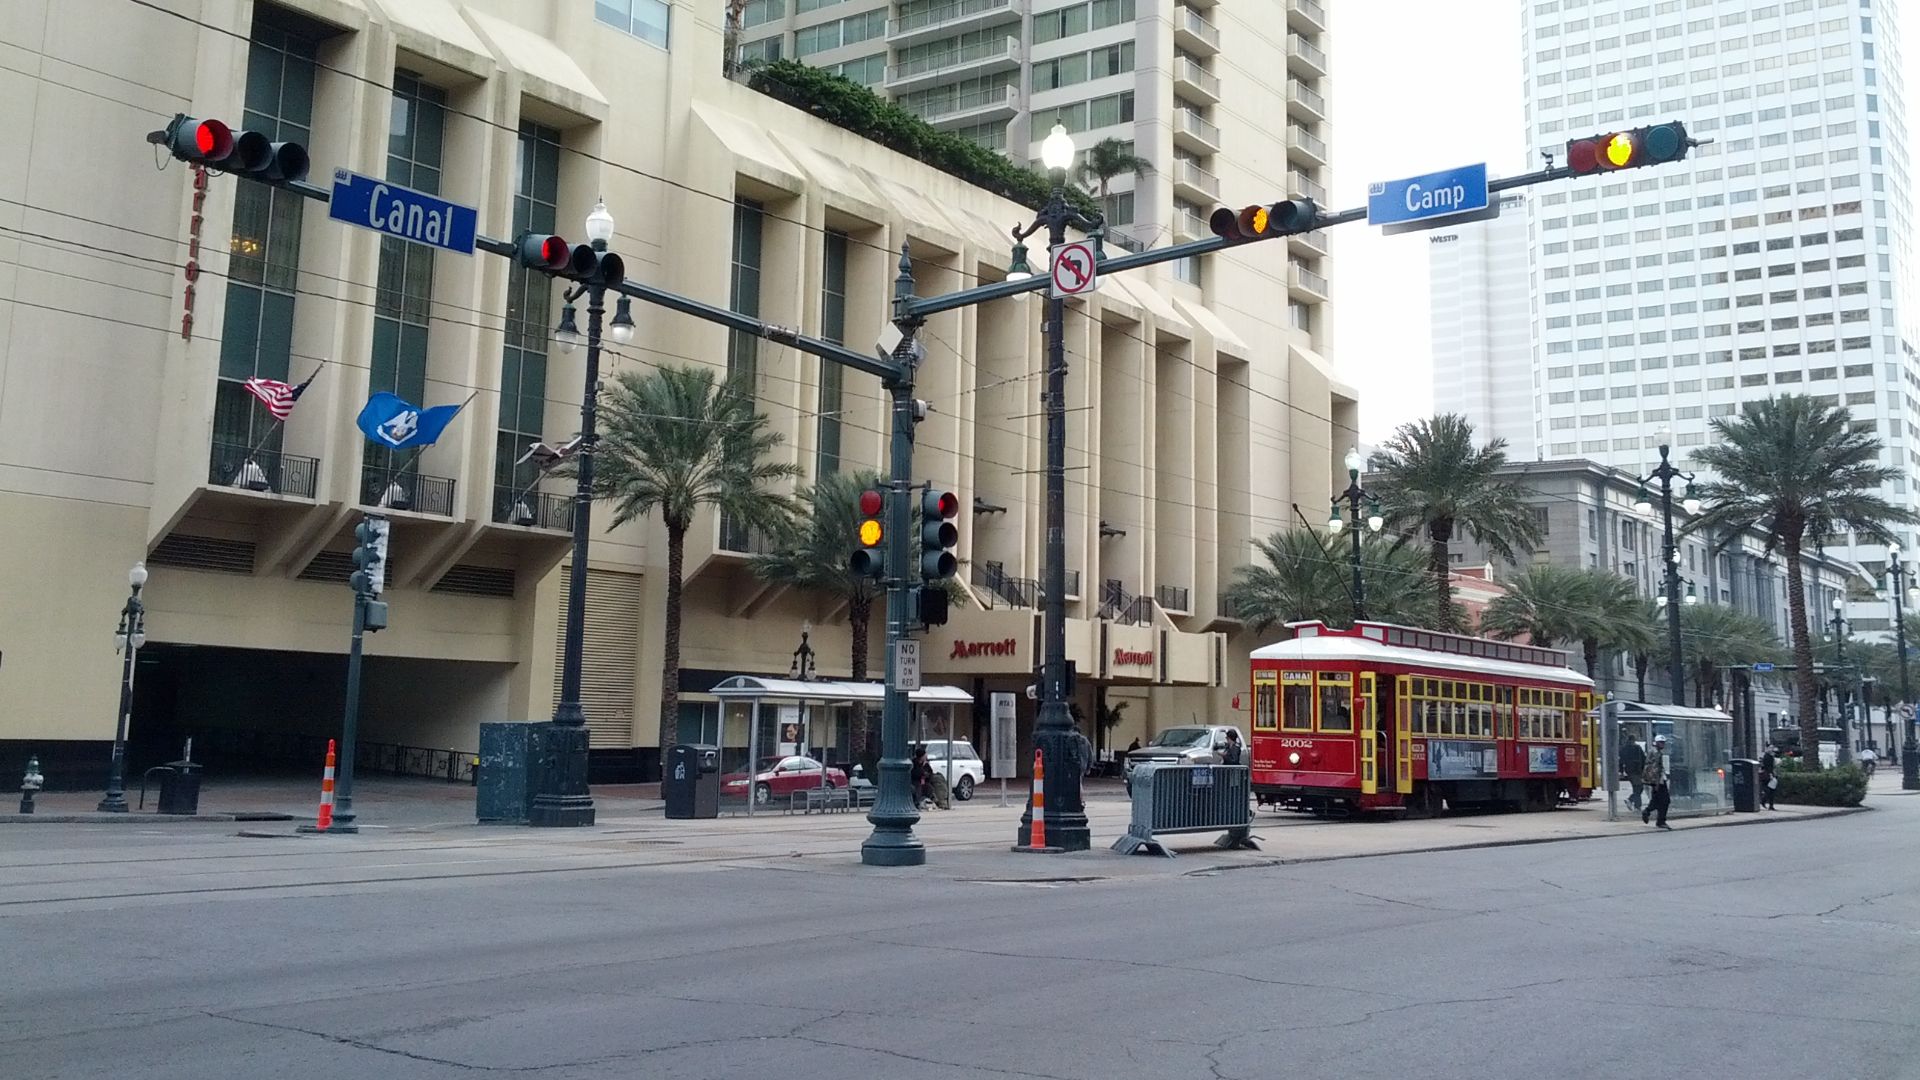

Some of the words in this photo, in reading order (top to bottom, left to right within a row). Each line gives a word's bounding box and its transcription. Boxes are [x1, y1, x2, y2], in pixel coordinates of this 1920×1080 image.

[1405, 183, 1465, 212] Camp
[369, 184, 453, 247] Canal
[182, 162, 207, 341] arriott
[901, 644, 915, 654] NO
[950, 638, 1016, 660] Marriott
[900, 657, 916, 665] TURN
[903, 667, 913, 675] ON
[902, 678, 914, 687] RED
[1281, 739, 1313, 748] 2002
